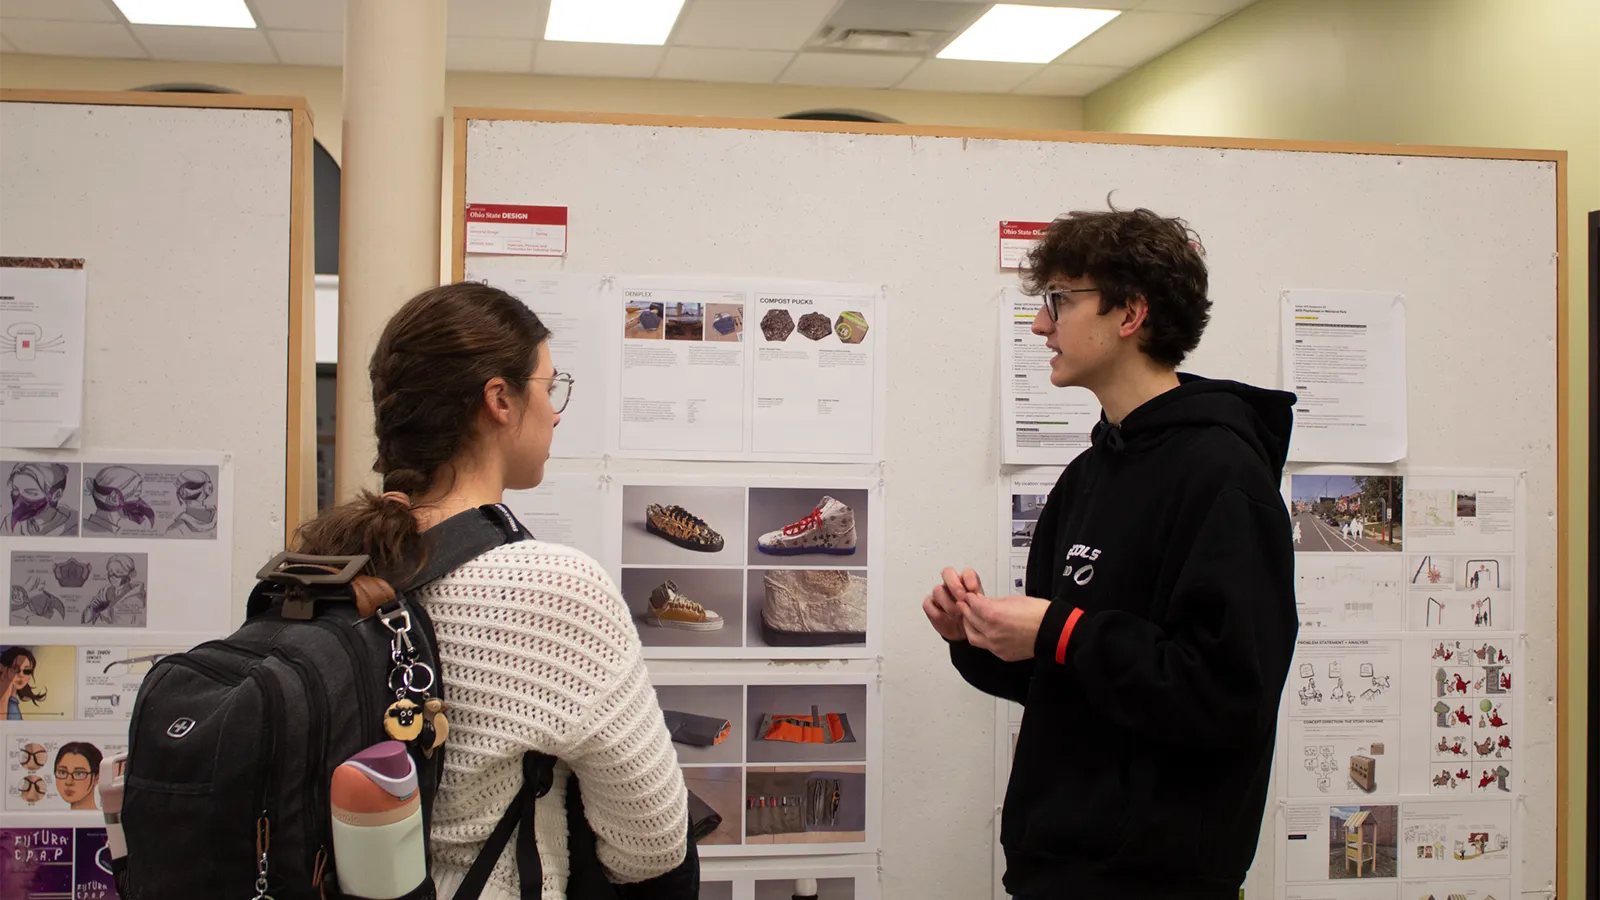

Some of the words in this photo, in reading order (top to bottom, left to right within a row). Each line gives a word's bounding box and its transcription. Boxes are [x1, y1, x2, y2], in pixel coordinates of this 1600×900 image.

[470, 211, 485, 219] Ohio
[501, 212, 528, 220] DESIGN
[15, 829, 68, 848] FUTURA
